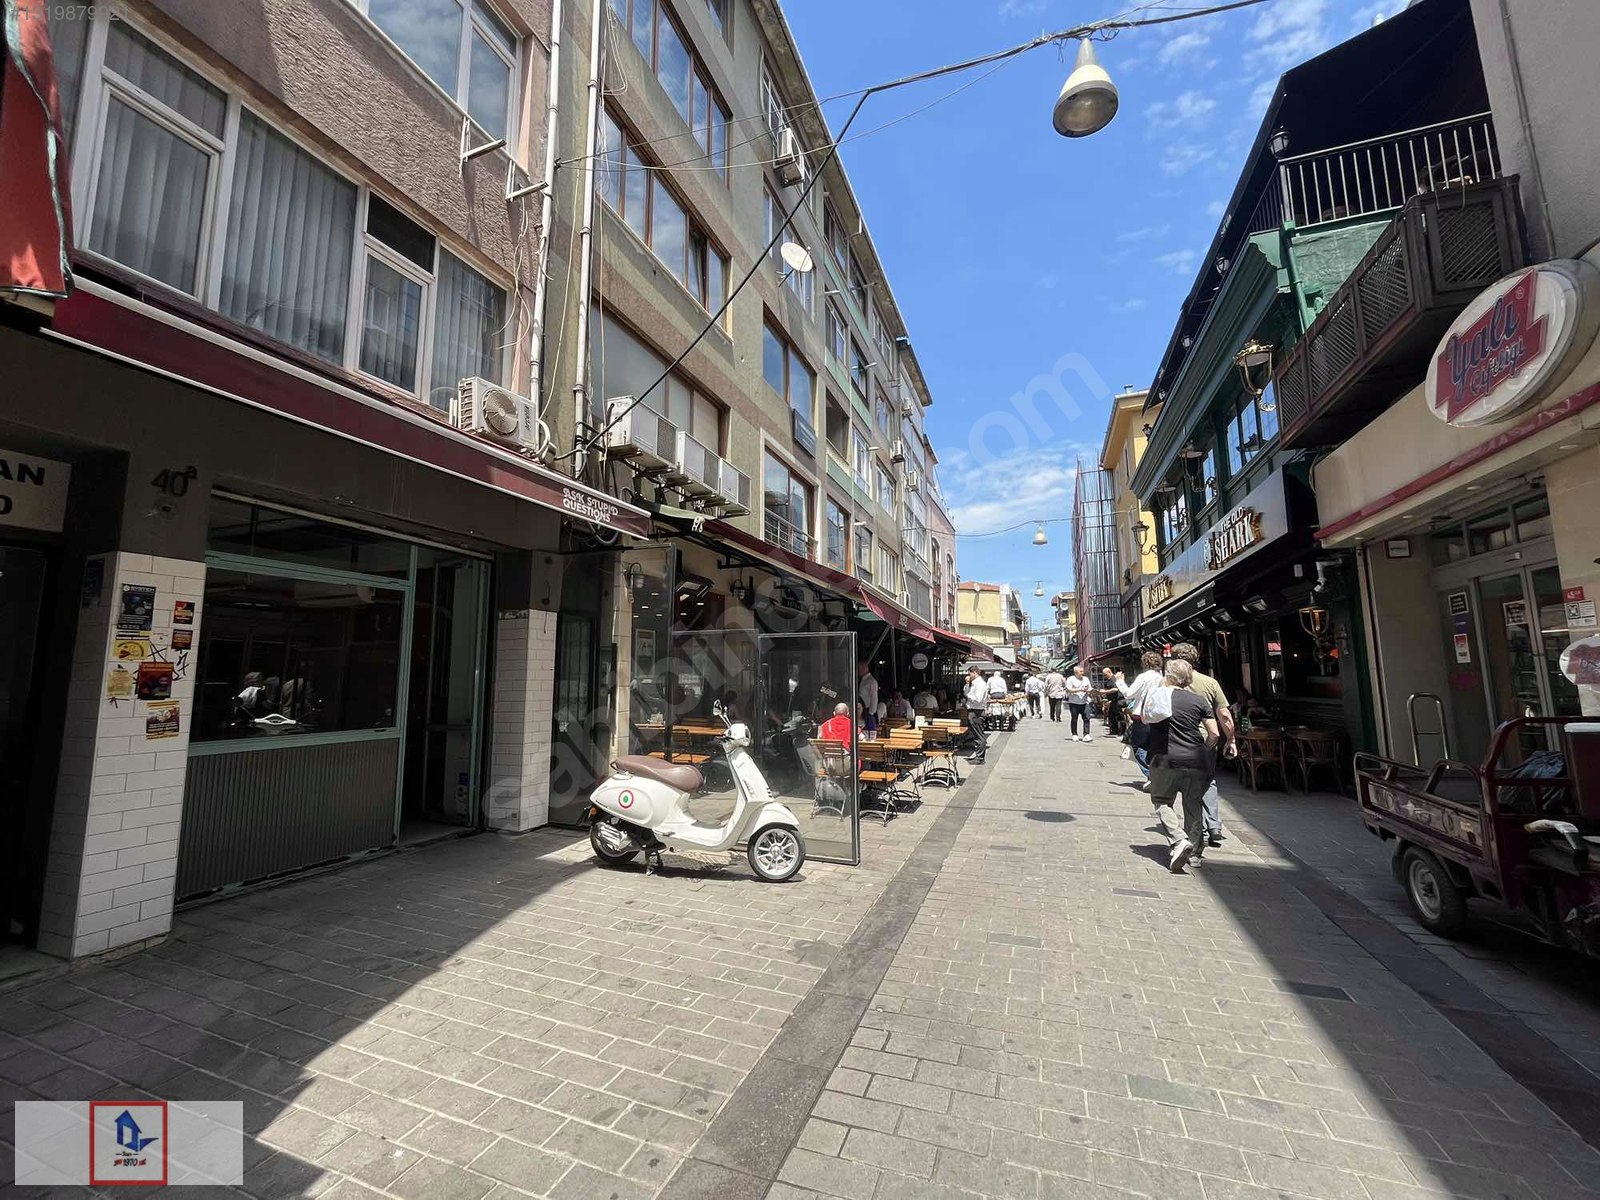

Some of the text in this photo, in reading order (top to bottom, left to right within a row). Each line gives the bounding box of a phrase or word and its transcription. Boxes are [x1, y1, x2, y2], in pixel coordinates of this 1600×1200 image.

[562, 487, 619, 516] ASK STUPID
[562, 499, 611, 523] QUESTIONS
[1221, 506, 1244, 532] THE OLD
[1214, 513, 1256, 564] SHARK
